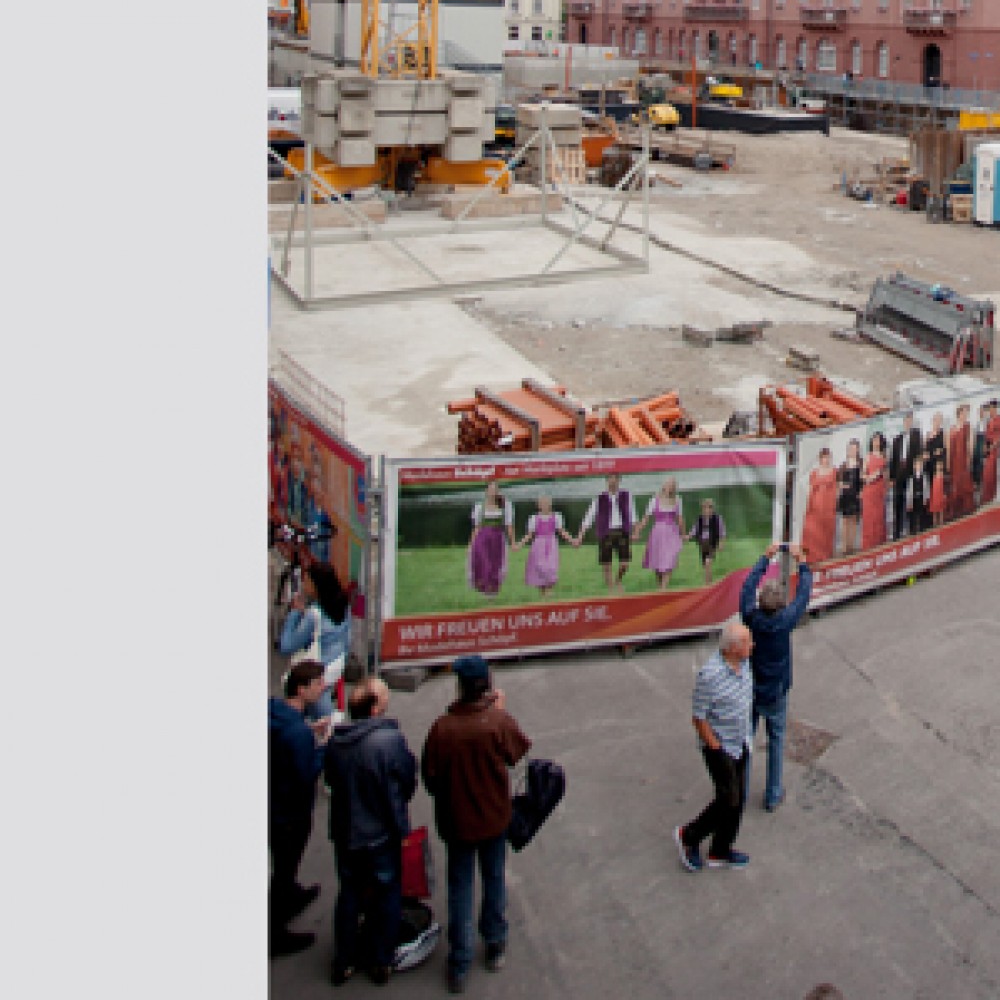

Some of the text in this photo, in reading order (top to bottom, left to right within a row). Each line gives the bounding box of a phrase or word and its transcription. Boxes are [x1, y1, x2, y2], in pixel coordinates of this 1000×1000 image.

[399, 624, 433, 641] WIR
[436, 617, 506, 639] FREUEN
[508, 612, 544, 630] UNS
[546, 608, 581, 626] AUF
